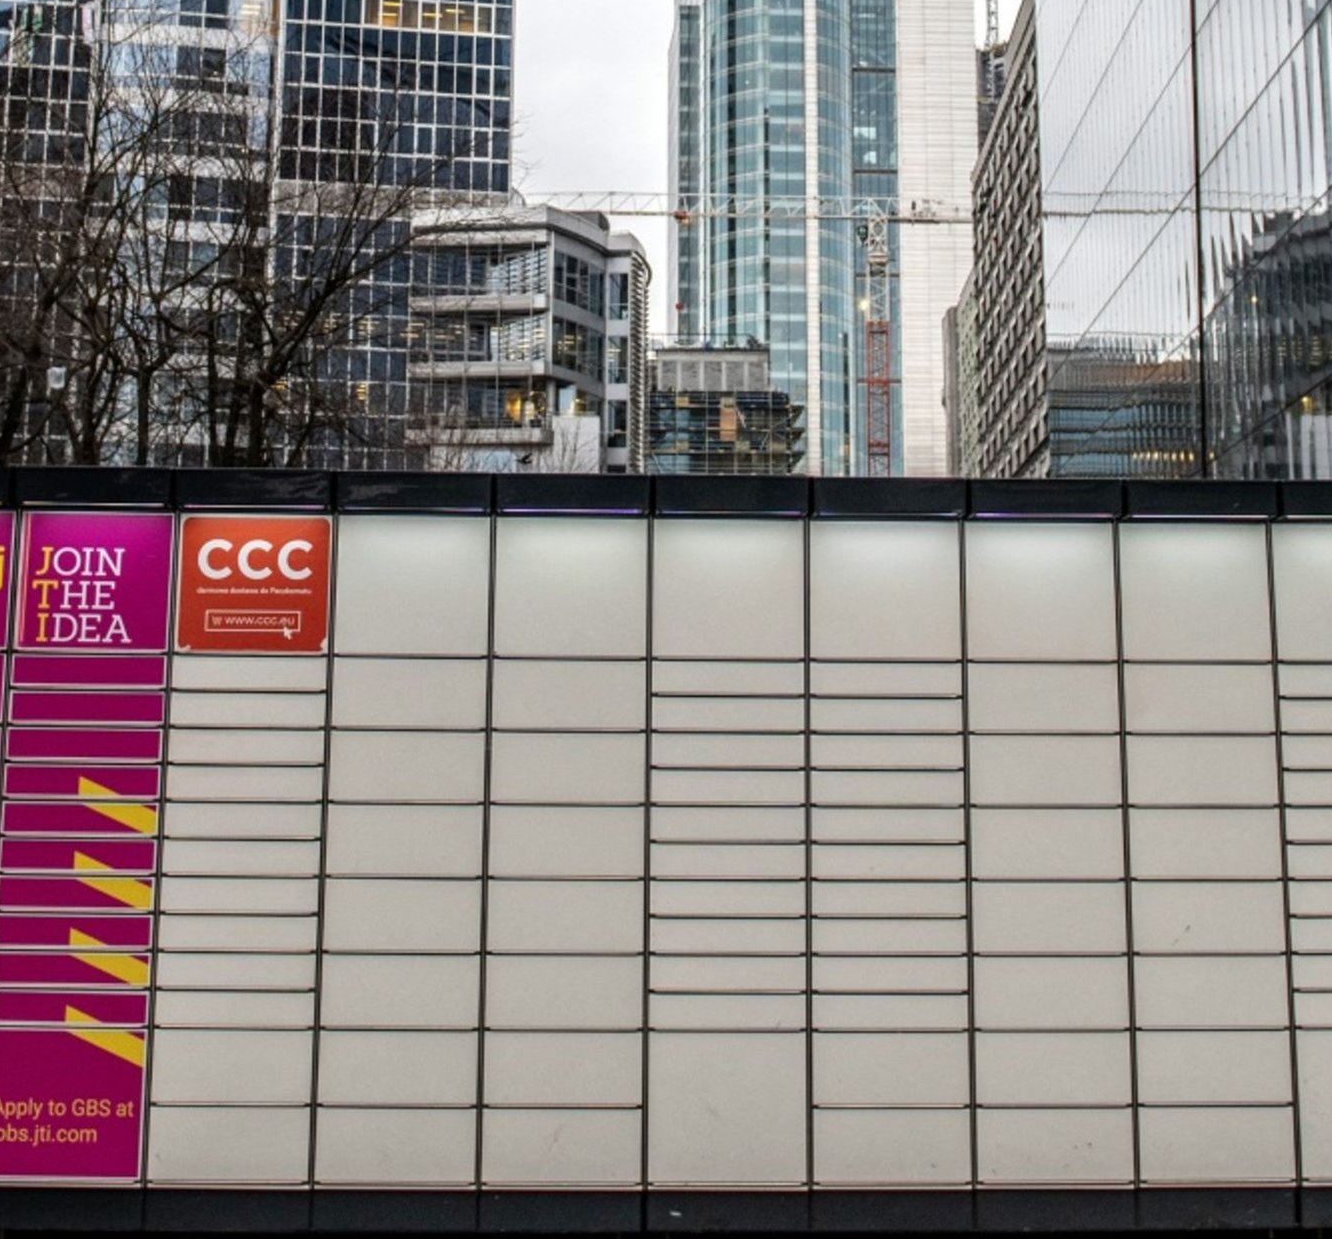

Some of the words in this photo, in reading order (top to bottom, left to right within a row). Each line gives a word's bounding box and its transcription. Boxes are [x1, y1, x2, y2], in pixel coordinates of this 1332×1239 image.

[35, 546, 126, 576] JOIN
[197, 538, 313, 581] CCC
[32, 580, 116, 610] THE
[36, 612, 132, 643] IDEA
[224, 616, 295, 626] www.ccc.eu
[48, 1099, 67, 1116] to
[72, 1098, 111, 1117] GBS
[116, 1100, 134, 1118] at
